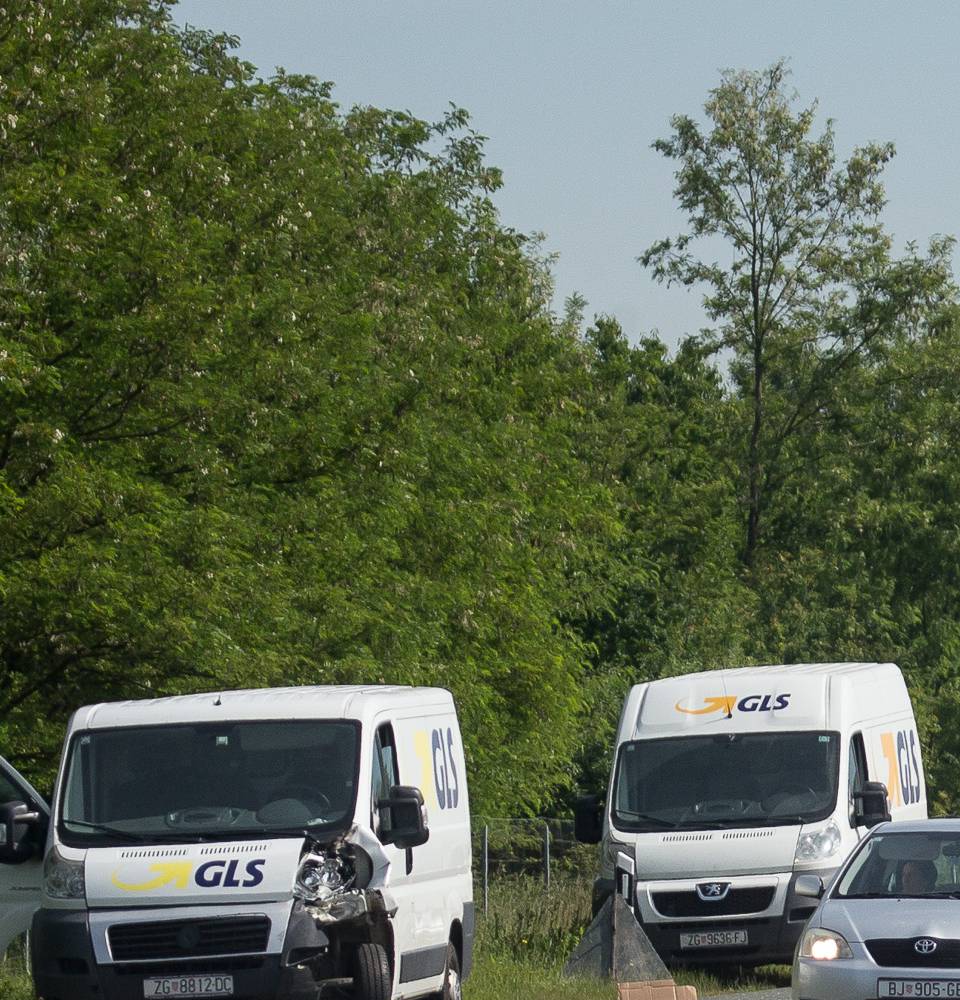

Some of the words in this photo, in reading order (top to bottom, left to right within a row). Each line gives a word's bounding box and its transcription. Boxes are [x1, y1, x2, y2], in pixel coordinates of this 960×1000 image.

[737, 693, 791, 712] GLS
[431, 727, 459, 810] GLS
[897, 729, 920, 805] GLS
[194, 858, 266, 888] GLS
[688, 933, 701, 946] ZG
[154, 980, 171, 994] ZG
[888, 981, 905, 996] BJ
